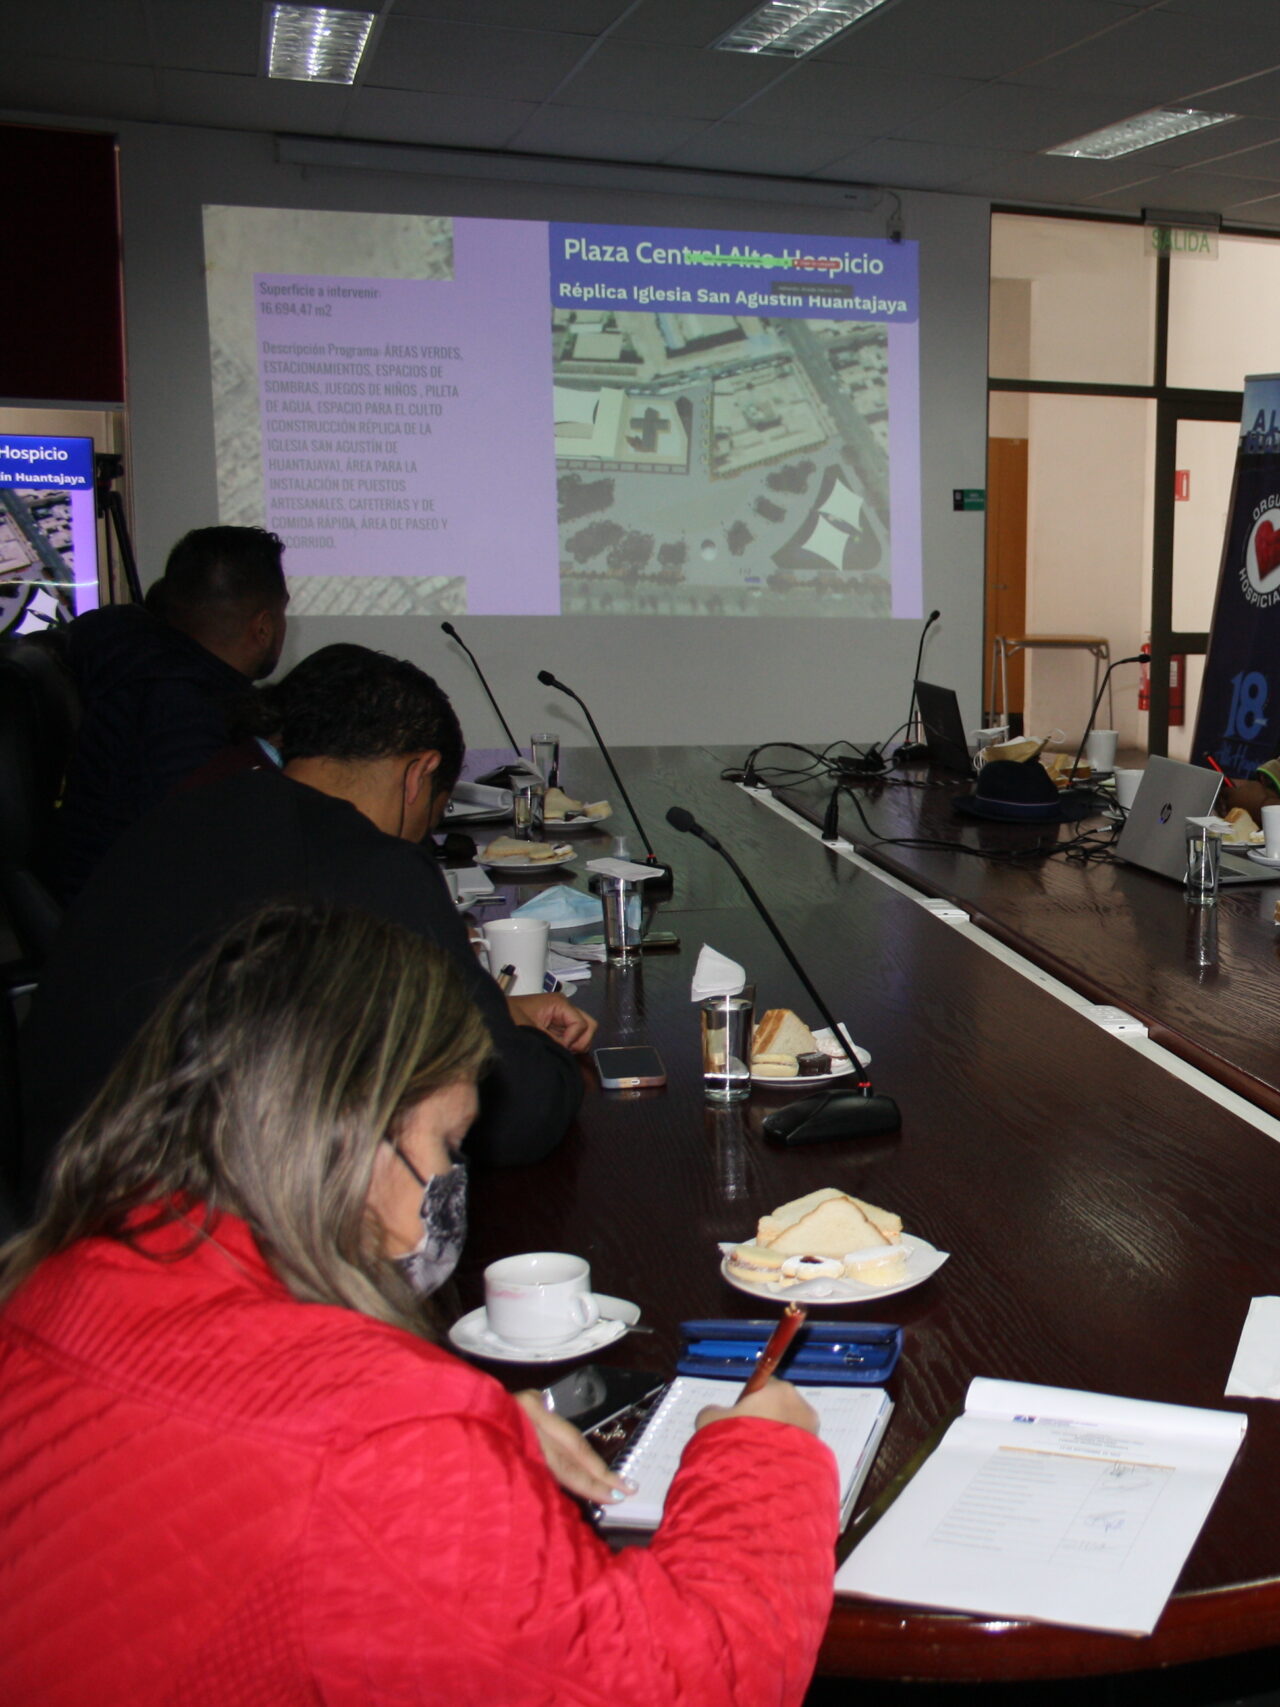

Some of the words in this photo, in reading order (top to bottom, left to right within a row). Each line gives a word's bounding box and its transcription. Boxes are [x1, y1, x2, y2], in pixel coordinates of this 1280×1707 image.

[1152, 227, 1210, 253] SALIDA
[564, 237, 630, 263] Plaza
[260, 283, 315, 298] Superficie
[318, 288, 325, 297] a
[559, 282, 628, 301] Réplica
[633, 286, 692, 304] Iglesia
[697, 288, 730, 304] San
[808, 295, 908, 314] Huantajaya
[314, 304, 332, 317] m2
[262, 341, 325, 358] Descripción
[384, 343, 418, 358] ÁREAS
[376, 364, 427, 378] ESPACIOS
[430, 366, 443, 378] DE
[325, 382, 368, 396] JUEGOS
[369, 383, 381, 396] DE
[384, 381, 417, 397] NIÑOS
[425, 384, 459, 397] PILETA
[266, 400, 278, 413] DE
[318, 401, 362, 415] ESPACIO
[365, 402, 393, 415] PARA
[395, 403, 406, 415] EL
[408, 404, 442, 417] CULTO
[359, 419, 401, 435] RÉPLICA
[404, 422, 416, 435] DE
[420, 423, 432, 435] LA
[267, 439, 309, 452] IGLESIA
[311, 440, 333, 453] SAN
[335, 438, 382, 454] AGUSTÍN
[385, 442, 398, 454] DE
[0, 445, 68, 464] Hospicio
[346, 457, 372, 473] ÁREA
[375, 460, 402, 473] PARA
[405, 461, 417, 473] LA
[15, 472, 86, 486] Huantajaya
[269, 476, 339, 491] INSTALACIÓN
[342, 479, 354, 491] DE
[358, 479, 406, 492] PUESTOS
[349, 497, 410, 512] CAFETERÍAS
[412, 499, 419, 511] Y
[422, 499, 434, 511] DE
[272, 516, 314, 530] COMIDA
[361, 516, 388, 530] ÁREA
[390, 518, 402, 530] DE
[405, 519, 438, 531] PASEO
[441, 519, 448, 530] Y
[1224, 671, 1268, 740] 18
